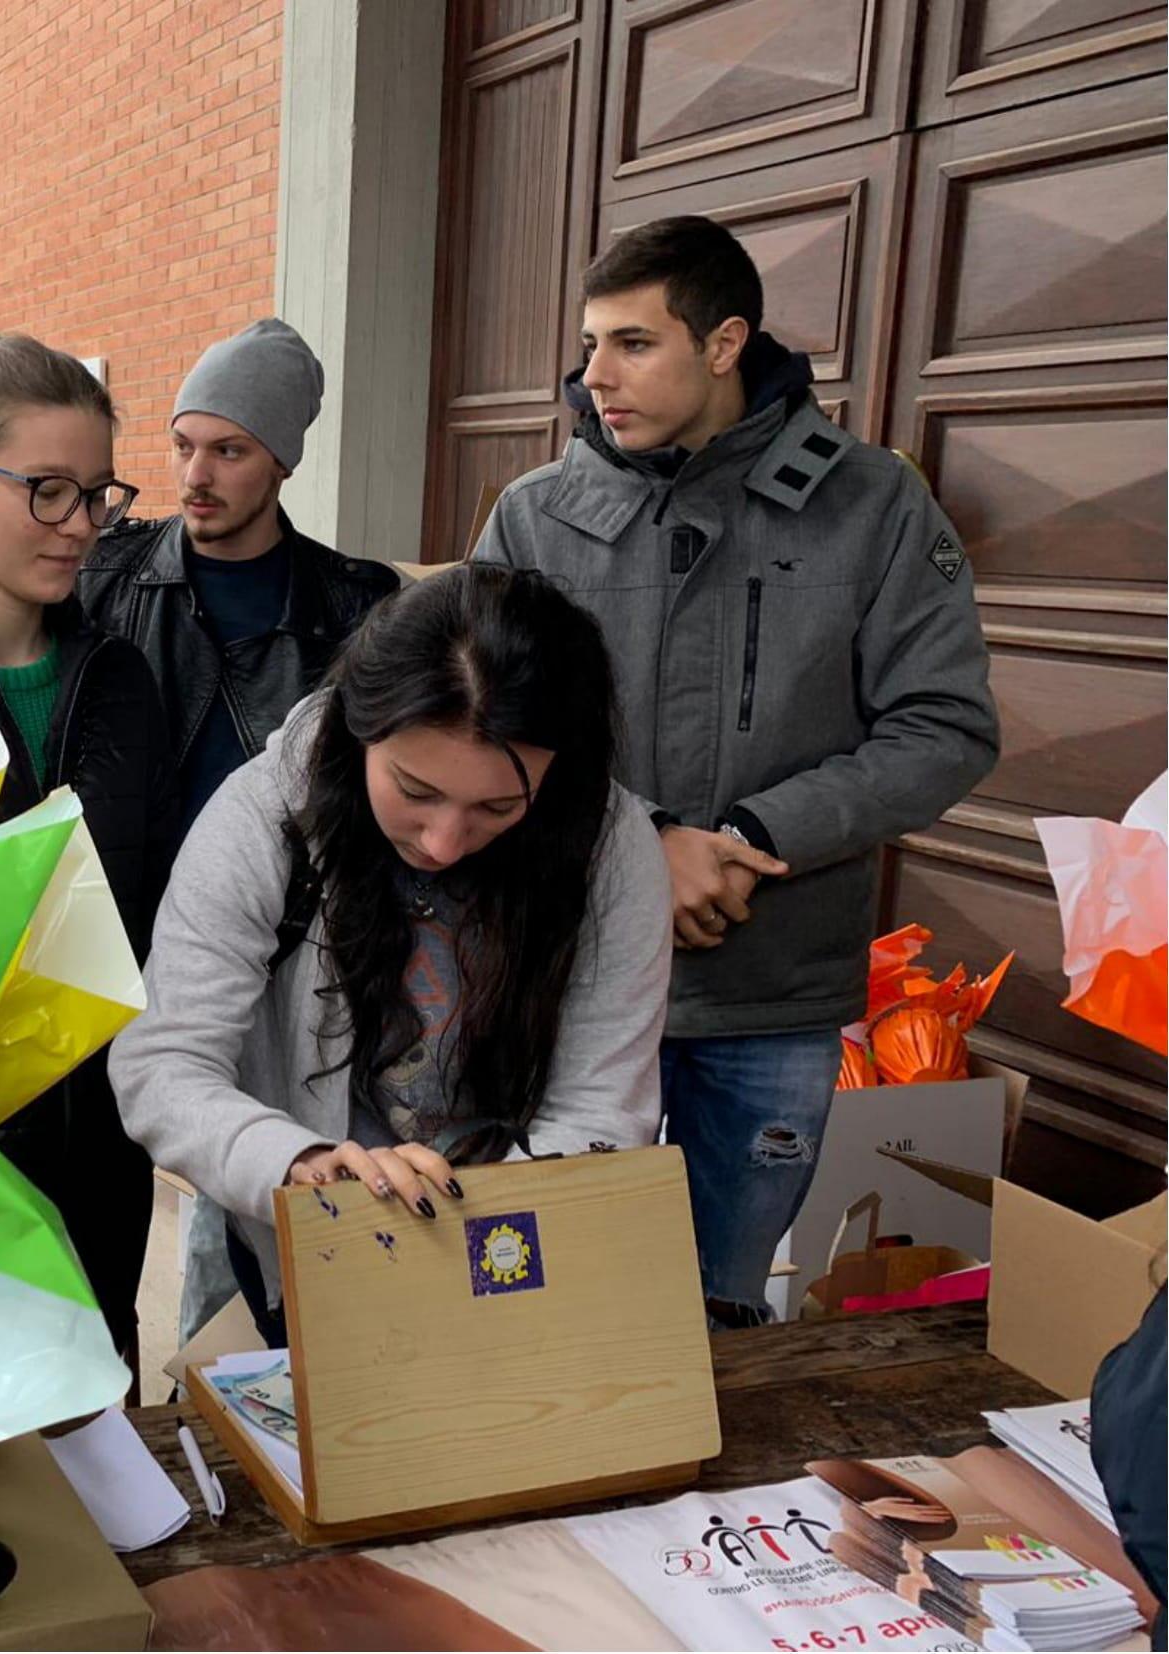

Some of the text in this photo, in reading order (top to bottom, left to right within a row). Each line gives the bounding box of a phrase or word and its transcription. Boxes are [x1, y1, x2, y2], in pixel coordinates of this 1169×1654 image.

[664, 1549, 711, 1577] 50
[707, 1583, 752, 1596] CONTRO
[877, 1611, 945, 1638] apri
